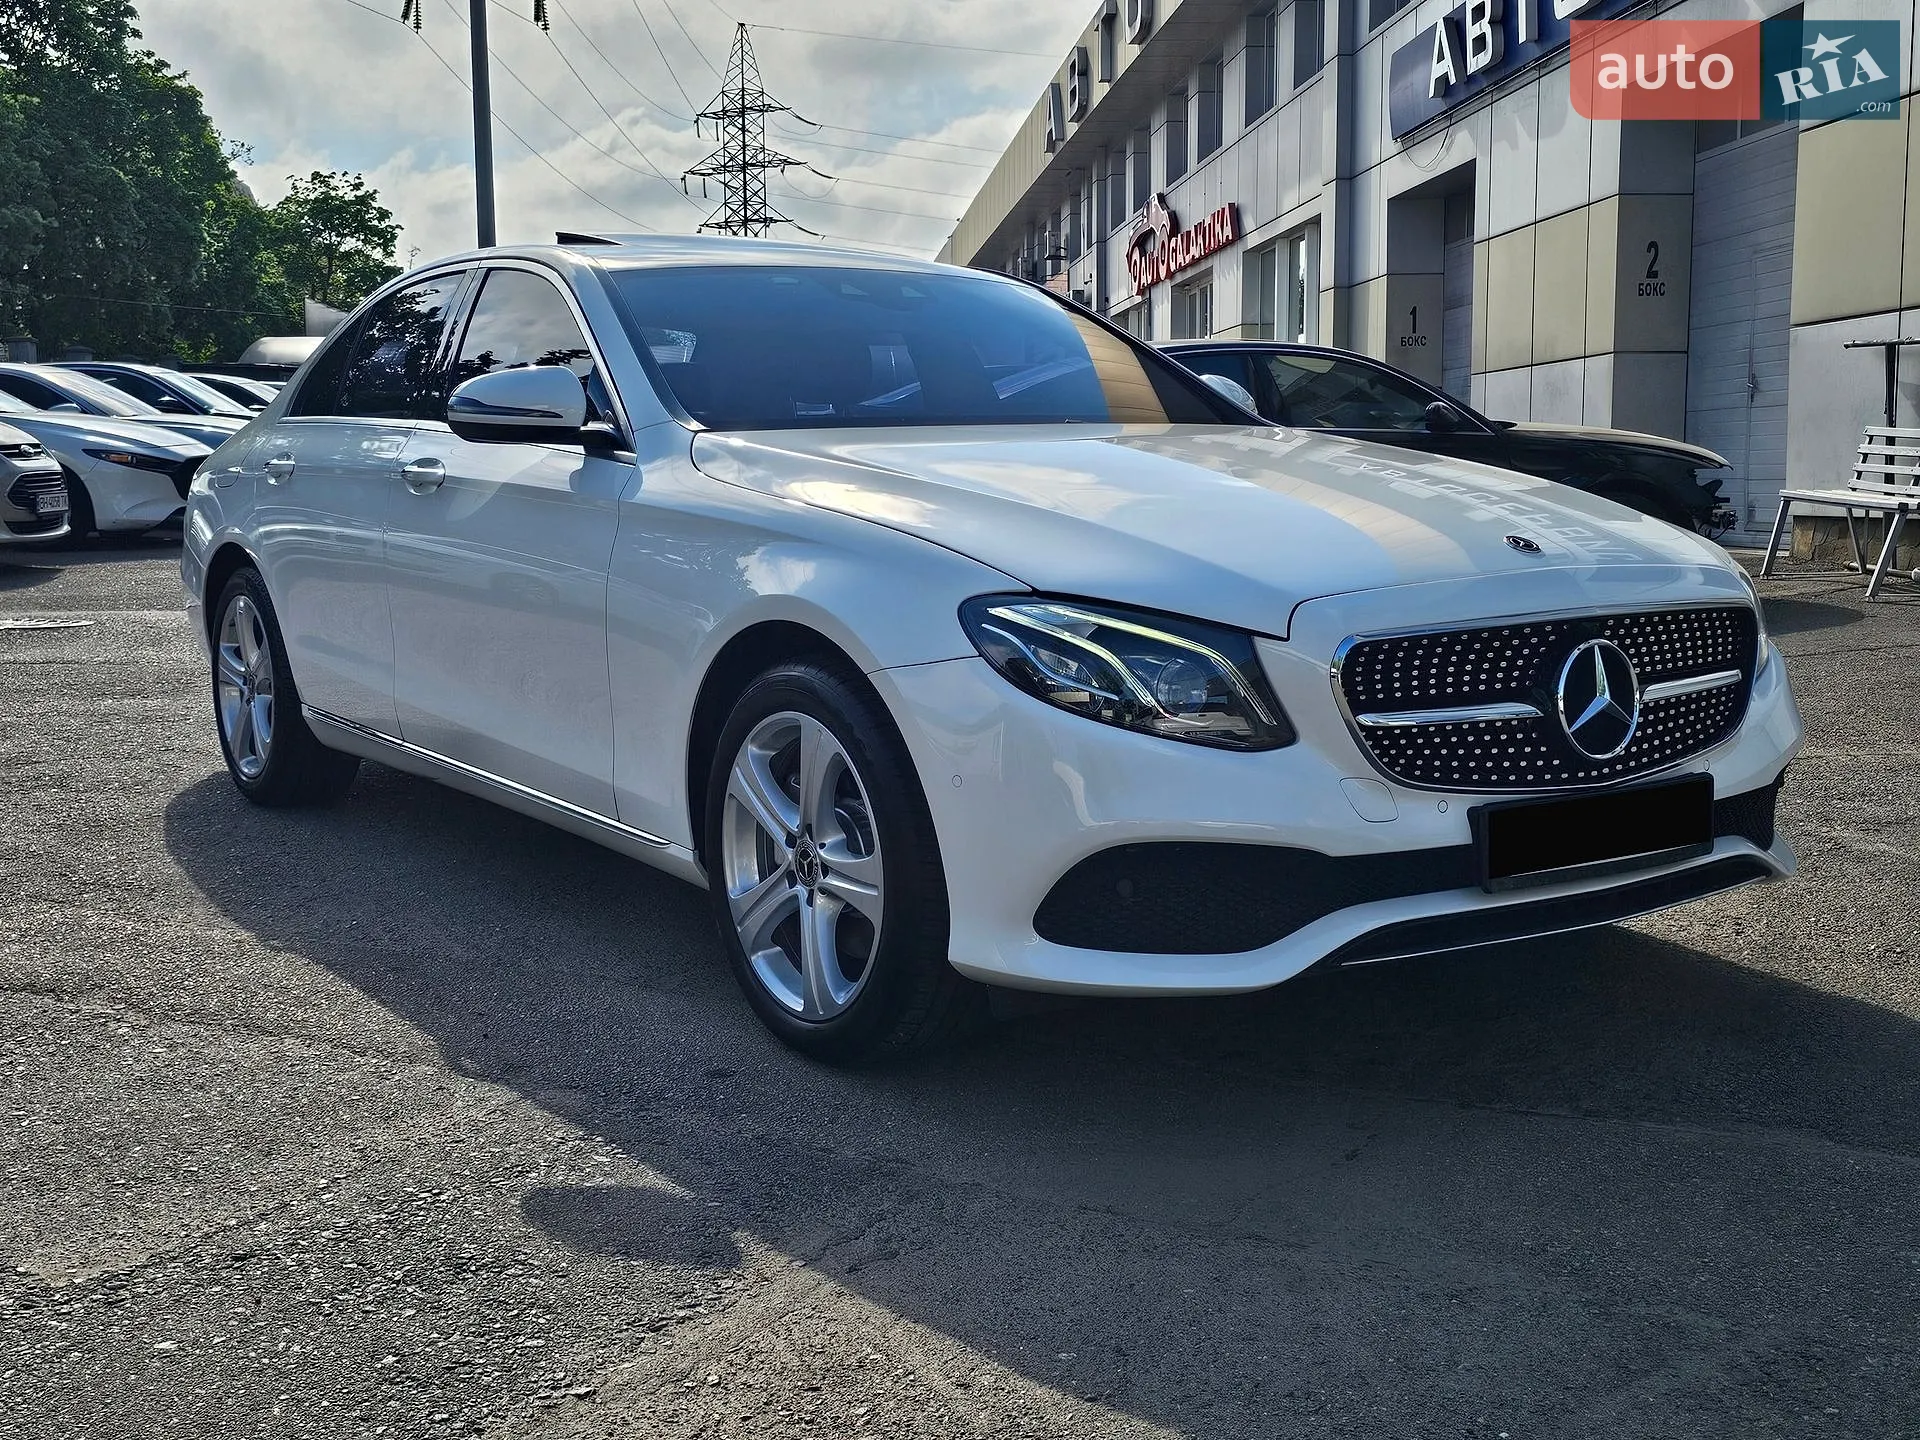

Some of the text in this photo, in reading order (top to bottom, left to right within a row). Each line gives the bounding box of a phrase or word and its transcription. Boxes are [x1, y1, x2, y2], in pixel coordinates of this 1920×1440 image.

[1646, 241, 1659, 279] 2
[1638, 282, 1666, 297] БОКС
[1409, 305, 1418, 334] 1
[1400, 335, 1427, 347] БОКС
